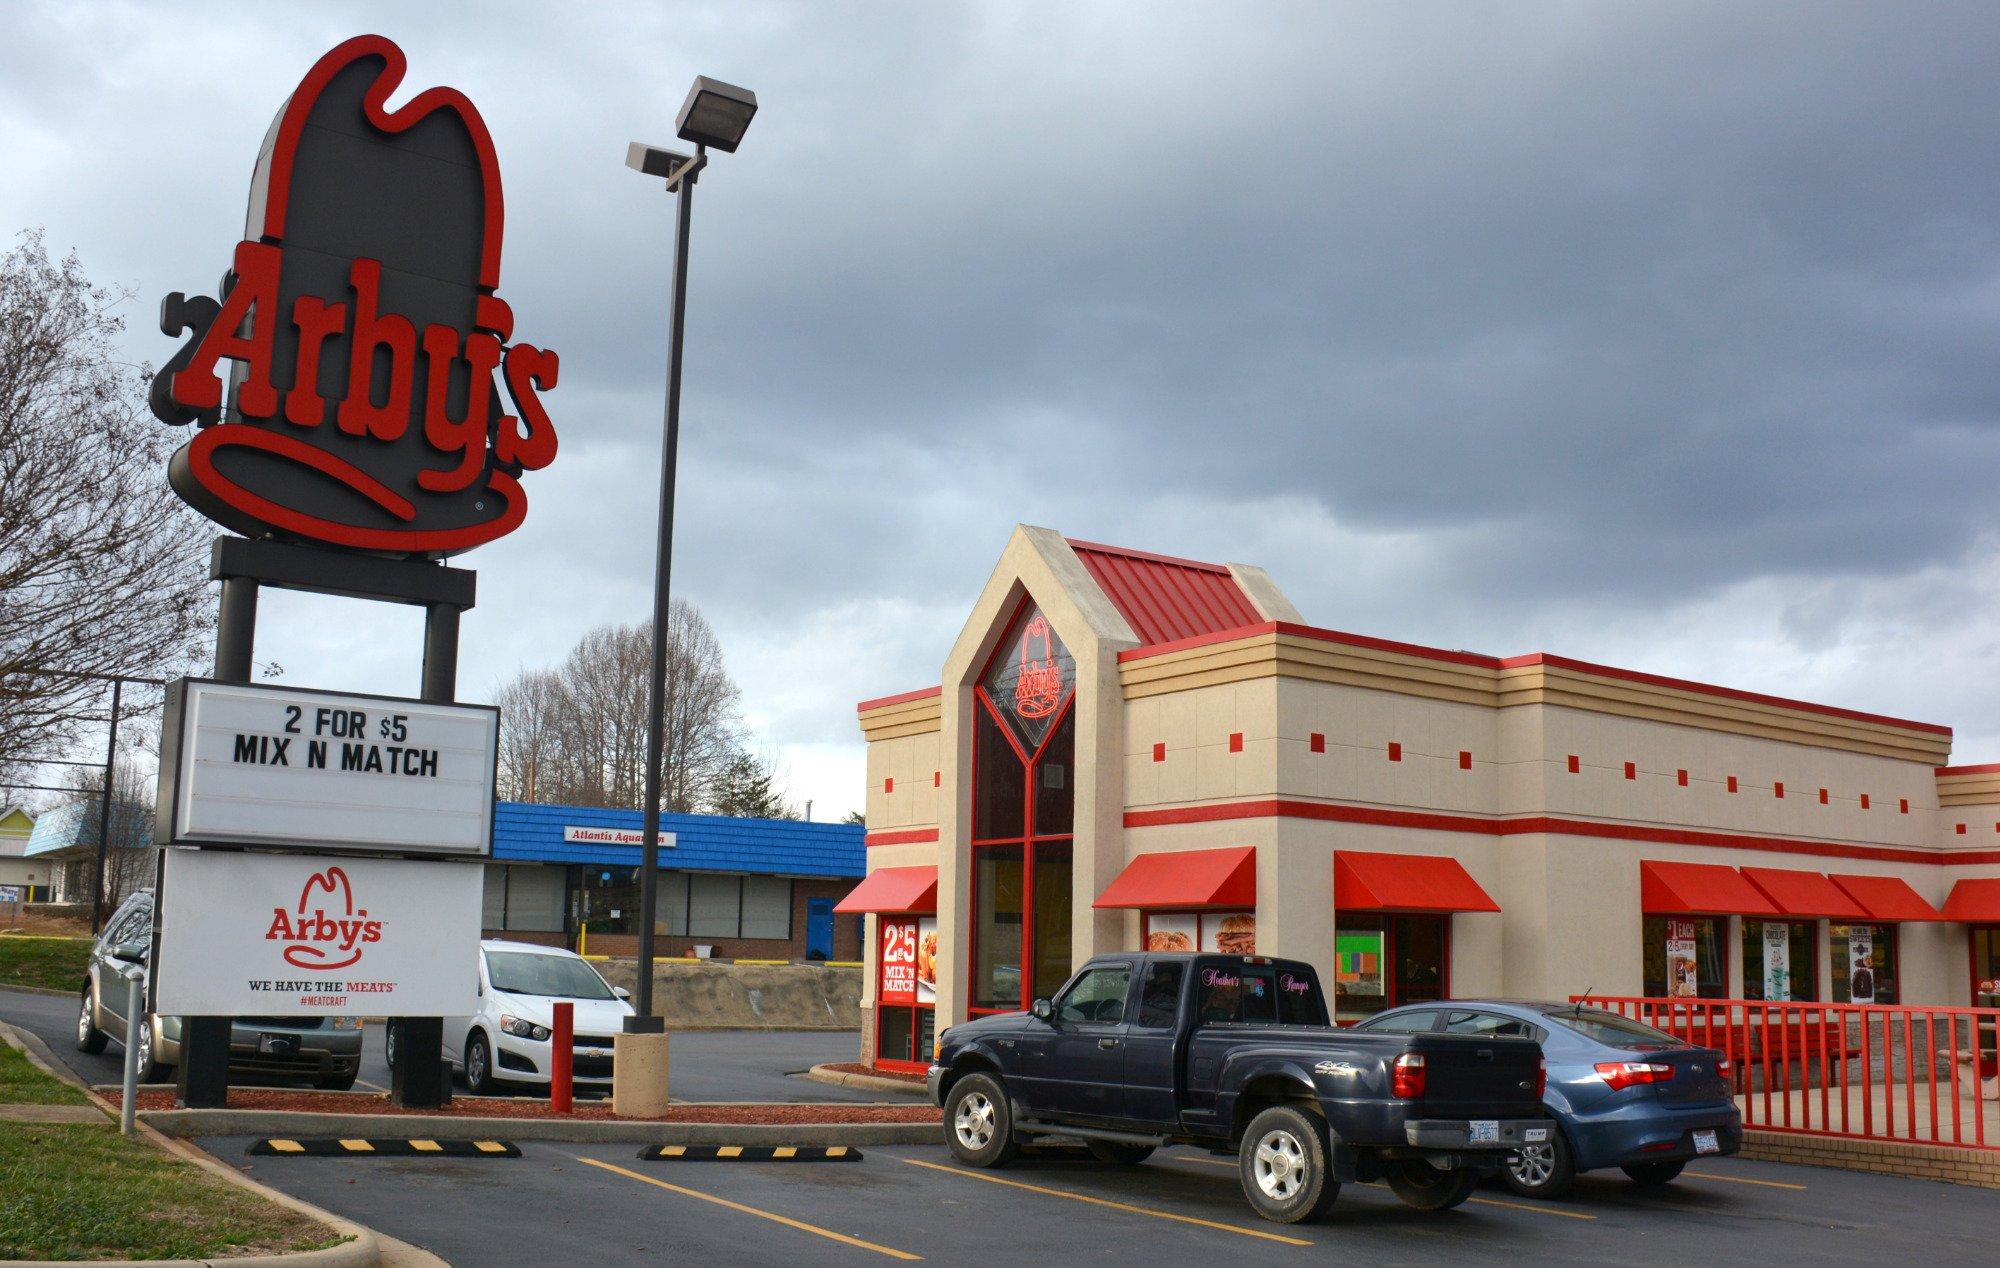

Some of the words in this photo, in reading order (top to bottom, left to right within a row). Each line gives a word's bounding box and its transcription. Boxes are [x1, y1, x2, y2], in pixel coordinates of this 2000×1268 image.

[172, 241, 559, 492] Arby's
[285, 705, 302, 733] 2
[315, 708, 366, 739] FOR
[380, 714, 408, 742] $5
[234, 734, 291, 766] MIX
[308, 740, 327, 769] N
[341, 742, 438, 777] MATCH
[572, 829, 612, 841] Atlantis
[265, 908, 382, 951] Arby's
[1679, 923, 1695, 938] EACH
[885, 966, 906, 979] MIX
[248, 980, 272, 992] WE
[275, 981, 313, 992] HAVE
[315, 981, 343, 993] THE
[346, 982, 393, 993] MEATS
[1280, 973, 1310, 996] Ranger
[300, 996, 348, 1006] #MEATCRAFT
